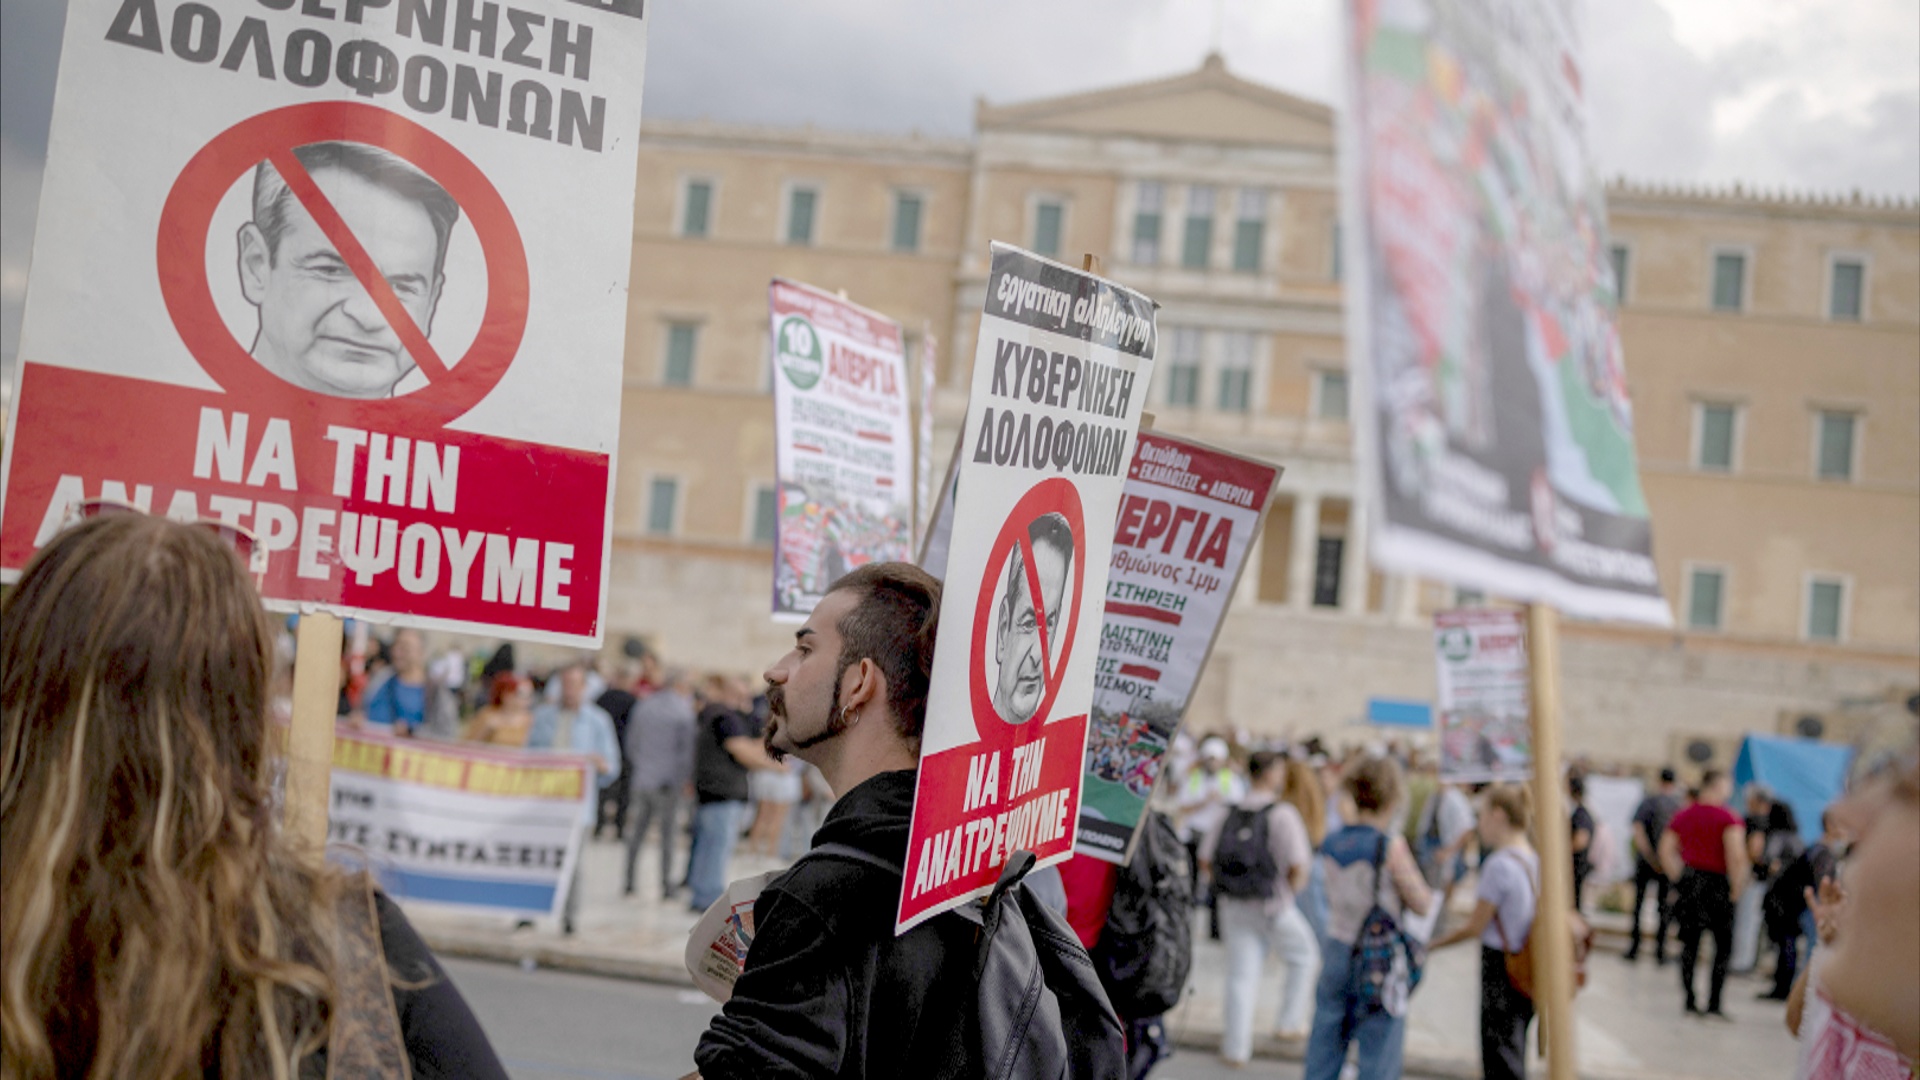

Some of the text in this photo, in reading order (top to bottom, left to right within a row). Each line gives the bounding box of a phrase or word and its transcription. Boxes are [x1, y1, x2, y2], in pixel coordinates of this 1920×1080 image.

[104, 0, 607, 154] ΔΟΛΟΦΟΝΩΝ
[784, 322, 813, 358] 10
[991, 338, 1135, 420] ΚΥΒΕΡΝΗΣΗ
[193, 406, 460, 513] ΝΑ ΤΗΝ
[973, 407, 1127, 477] ΔΟΛΟΦΟΝΩΝ
[1208, 480, 1254, 508] ΑΠΕΡΓΙΑ
[1114, 493, 1234, 569] ΕΡΓΙΑ
[1112, 581, 1188, 611] ΣΤΗΡΙΞΗ
[1125, 643, 1146, 657] THE
[1146, 649, 1169, 664] SEA
[963, 737, 1046, 813] ΝΑ ΤΗΝ
[387, 827, 567, 869] ΣΥΝΤΑΞΕΙΣ
[911, 788, 1071, 901] ΑΝΑΤΡΕΨΟΥΜΕ
